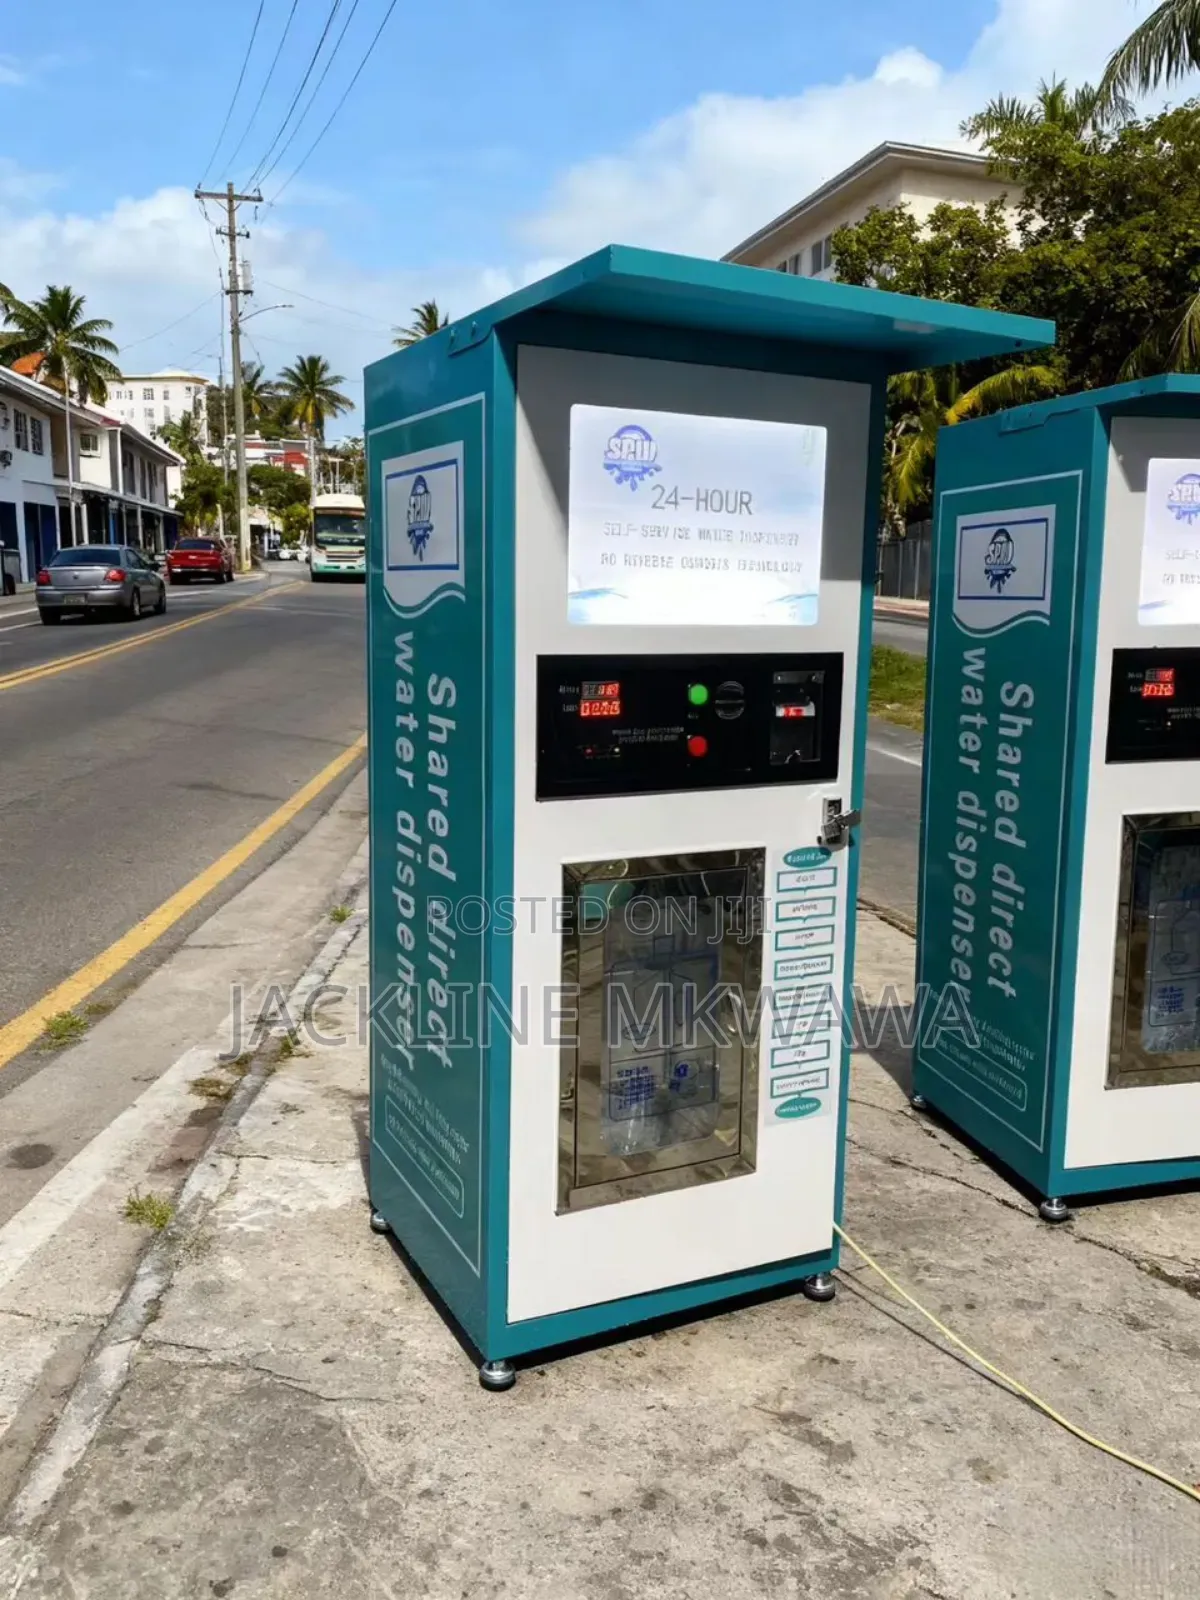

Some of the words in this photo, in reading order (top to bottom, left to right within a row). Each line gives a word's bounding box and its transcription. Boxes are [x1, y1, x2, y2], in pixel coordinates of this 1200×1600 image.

[651, 484, 754, 516] 24-HOUR
[394, 631, 419, 789] water
[427, 673, 457, 882] Shared
[958, 647, 989, 774] water
[994, 680, 1035, 848] Shared
[392, 810, 422, 1072] dispenser
[948, 790, 987, 1003] dispenser
[987, 862, 1026, 998] direct
[427, 900, 456, 1069] direct
